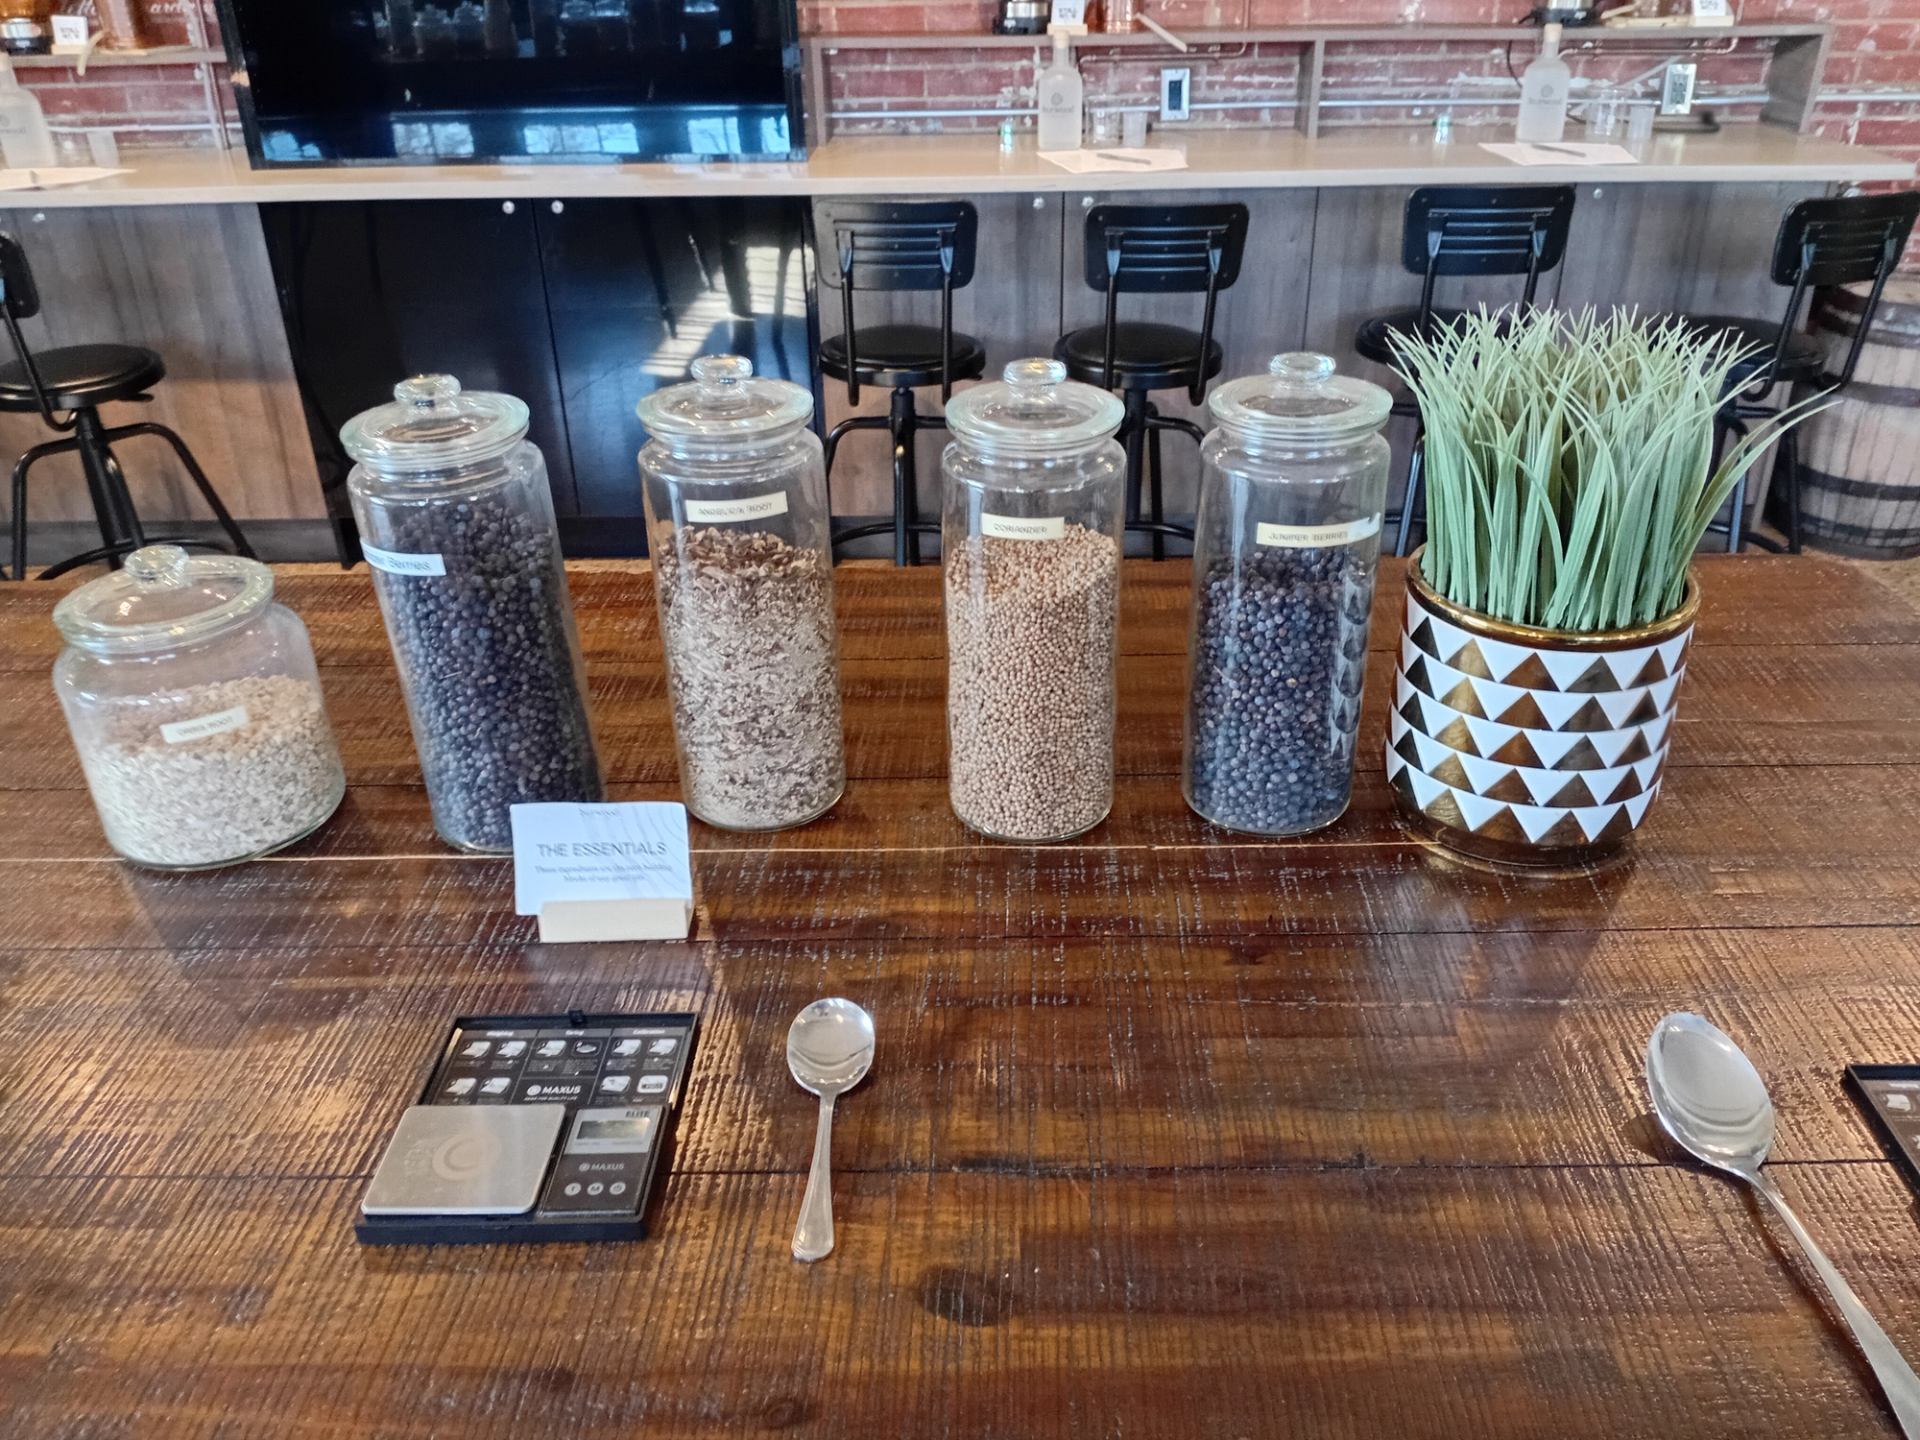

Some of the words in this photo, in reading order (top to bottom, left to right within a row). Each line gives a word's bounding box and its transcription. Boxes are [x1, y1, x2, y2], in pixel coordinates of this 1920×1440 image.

[536, 843, 568, 857] THE
[572, 841, 667, 857] ESSENTIALS
[542, 1085, 582, 1095] MAXUS
[626, 1110, 649, 1118] ELITE
[591, 1162, 625, 1172] MAXUS
